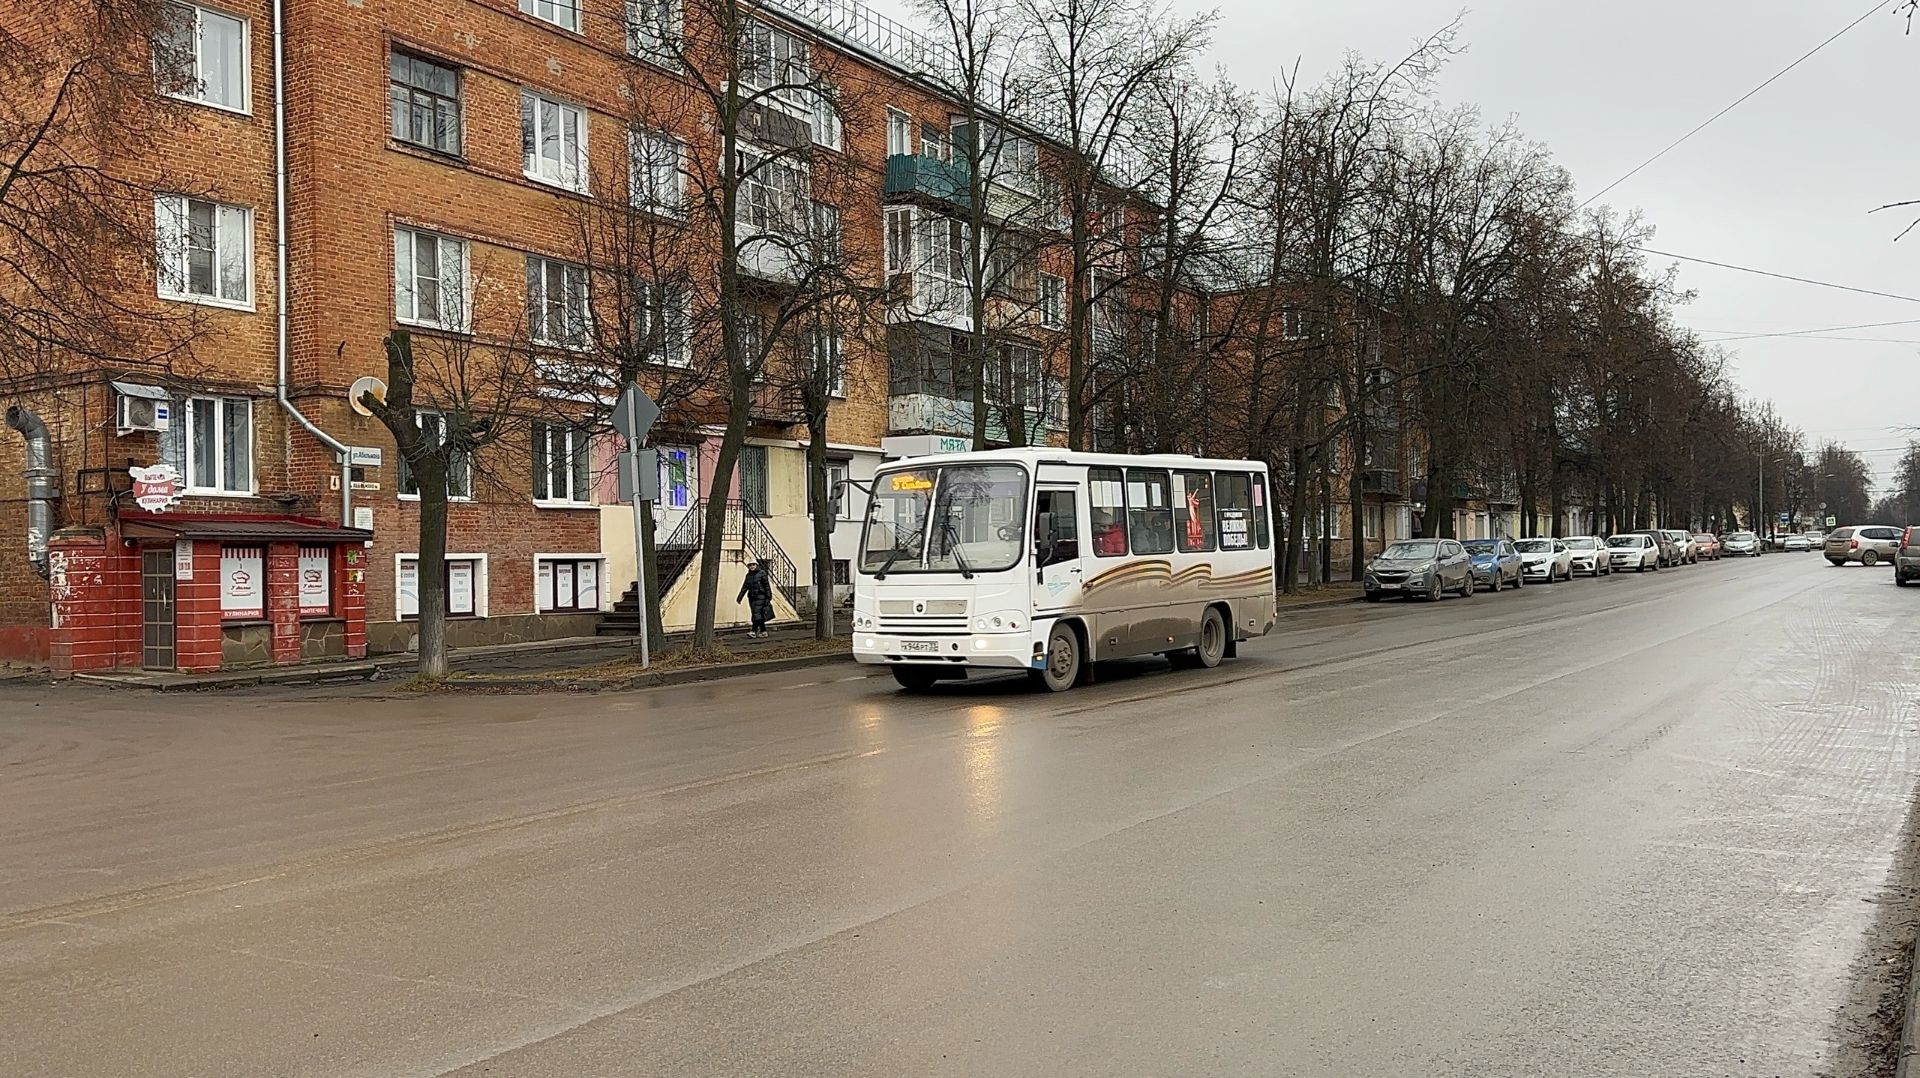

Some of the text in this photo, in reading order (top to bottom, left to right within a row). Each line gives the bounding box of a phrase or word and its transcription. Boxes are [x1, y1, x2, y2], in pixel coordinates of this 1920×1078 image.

[940, 438, 967, 452] МЯТА
[148, 484, 168, 494] дома
[1222, 519, 1247, 532] ВЕЛИКОЙ
